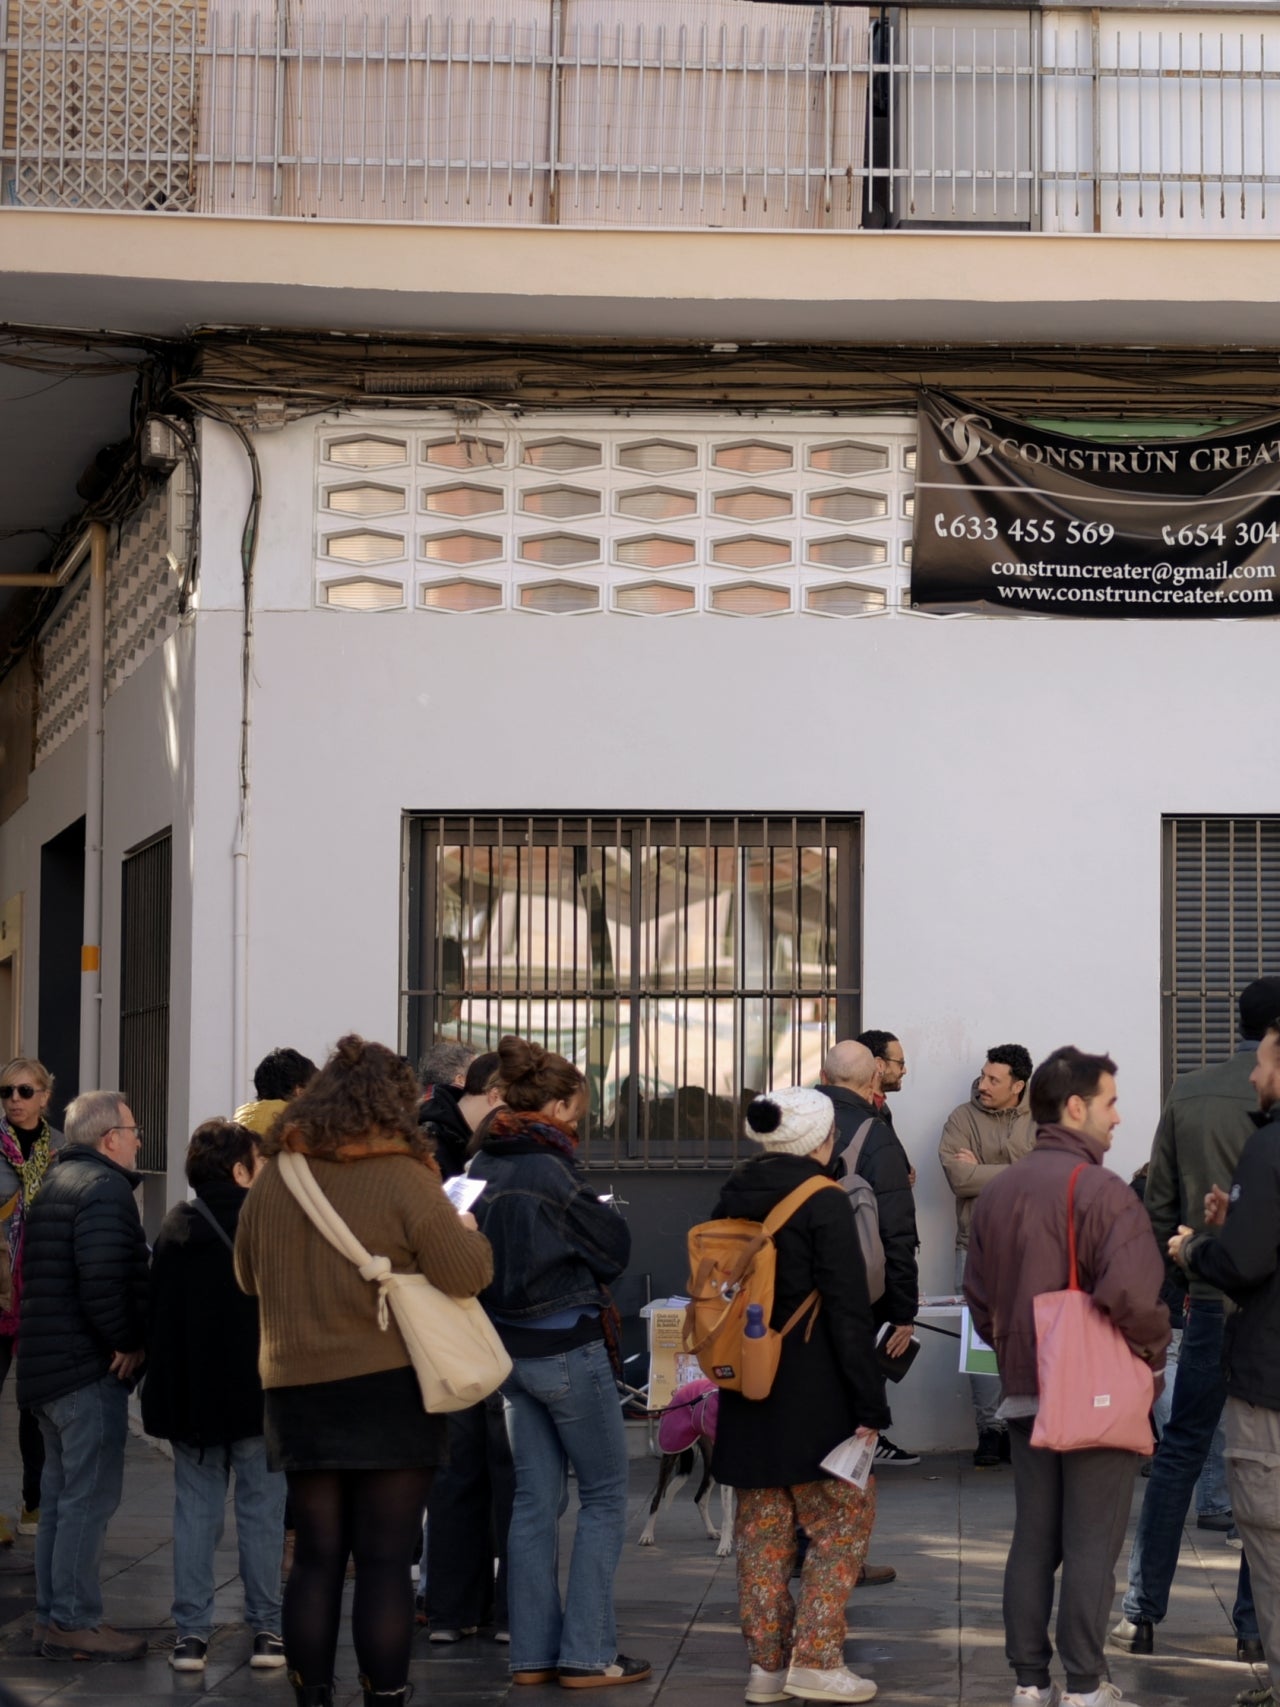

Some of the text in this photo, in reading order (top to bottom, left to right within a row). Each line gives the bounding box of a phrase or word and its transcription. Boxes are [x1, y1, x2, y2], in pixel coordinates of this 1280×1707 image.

[999, 438, 1179, 474] CONSTRÙN
[950, 514, 1116, 546] 633 455 569
[1177, 523, 1227, 547] 654
[1234, 521, 1280, 546] 304
[991, 560, 1276, 586] construncreater@gmail.com
[997, 585, 1274, 604] www.construncreater.com
